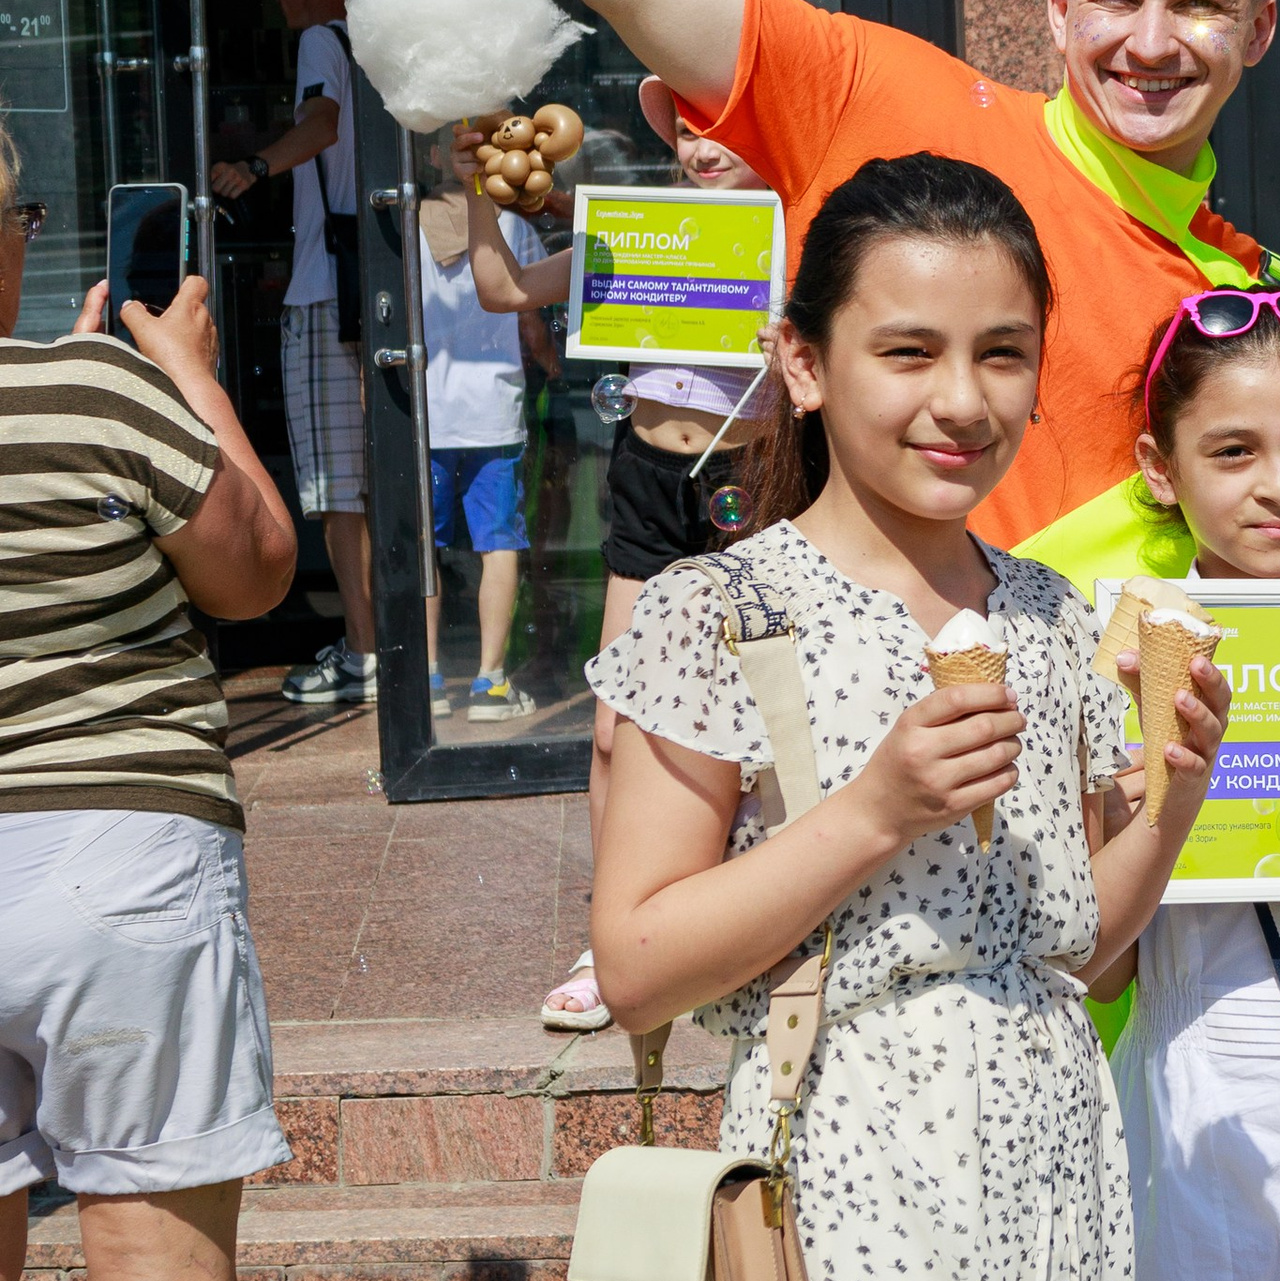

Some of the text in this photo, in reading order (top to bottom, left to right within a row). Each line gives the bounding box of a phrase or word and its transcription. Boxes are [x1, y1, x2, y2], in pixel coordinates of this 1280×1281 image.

[594, 231, 690, 251] ДИПЛОМ
[591, 279, 749, 294] ВЫДАН САМОМУ ТАЛАНТЛИВОМУ
[591, 291, 687, 303] ЮНОМУ КОНДИТЕРУ
[1193, 822, 1228, 832] директор
[1229, 822, 1272, 832] универмага
